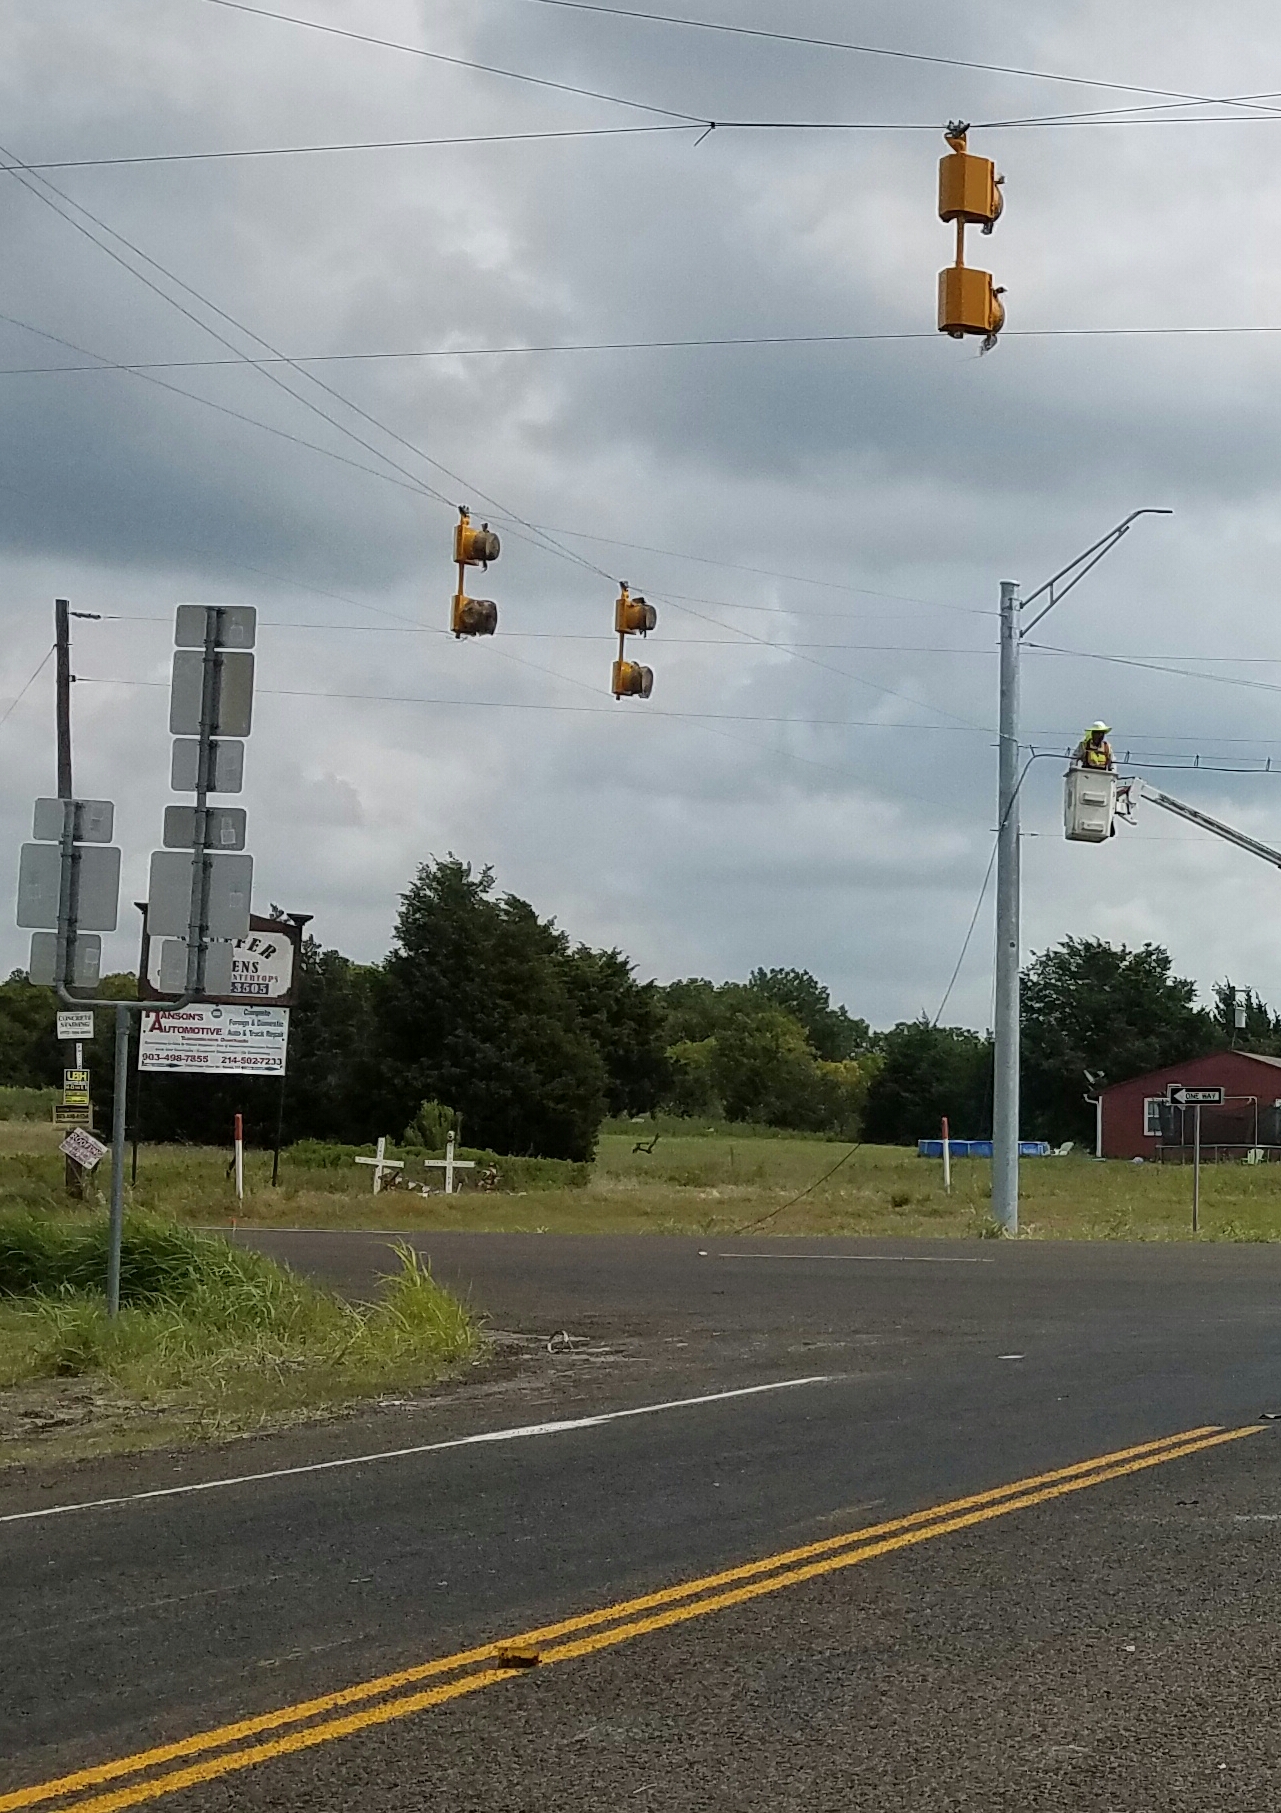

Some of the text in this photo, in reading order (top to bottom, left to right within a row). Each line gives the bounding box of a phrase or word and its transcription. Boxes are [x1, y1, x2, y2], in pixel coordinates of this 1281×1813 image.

[231, 960, 259, 974] ENS
[149, 1011, 222, 1035] AUTOMOTIVE
[1185, 1092, 1216, 1100] ONE WAY
